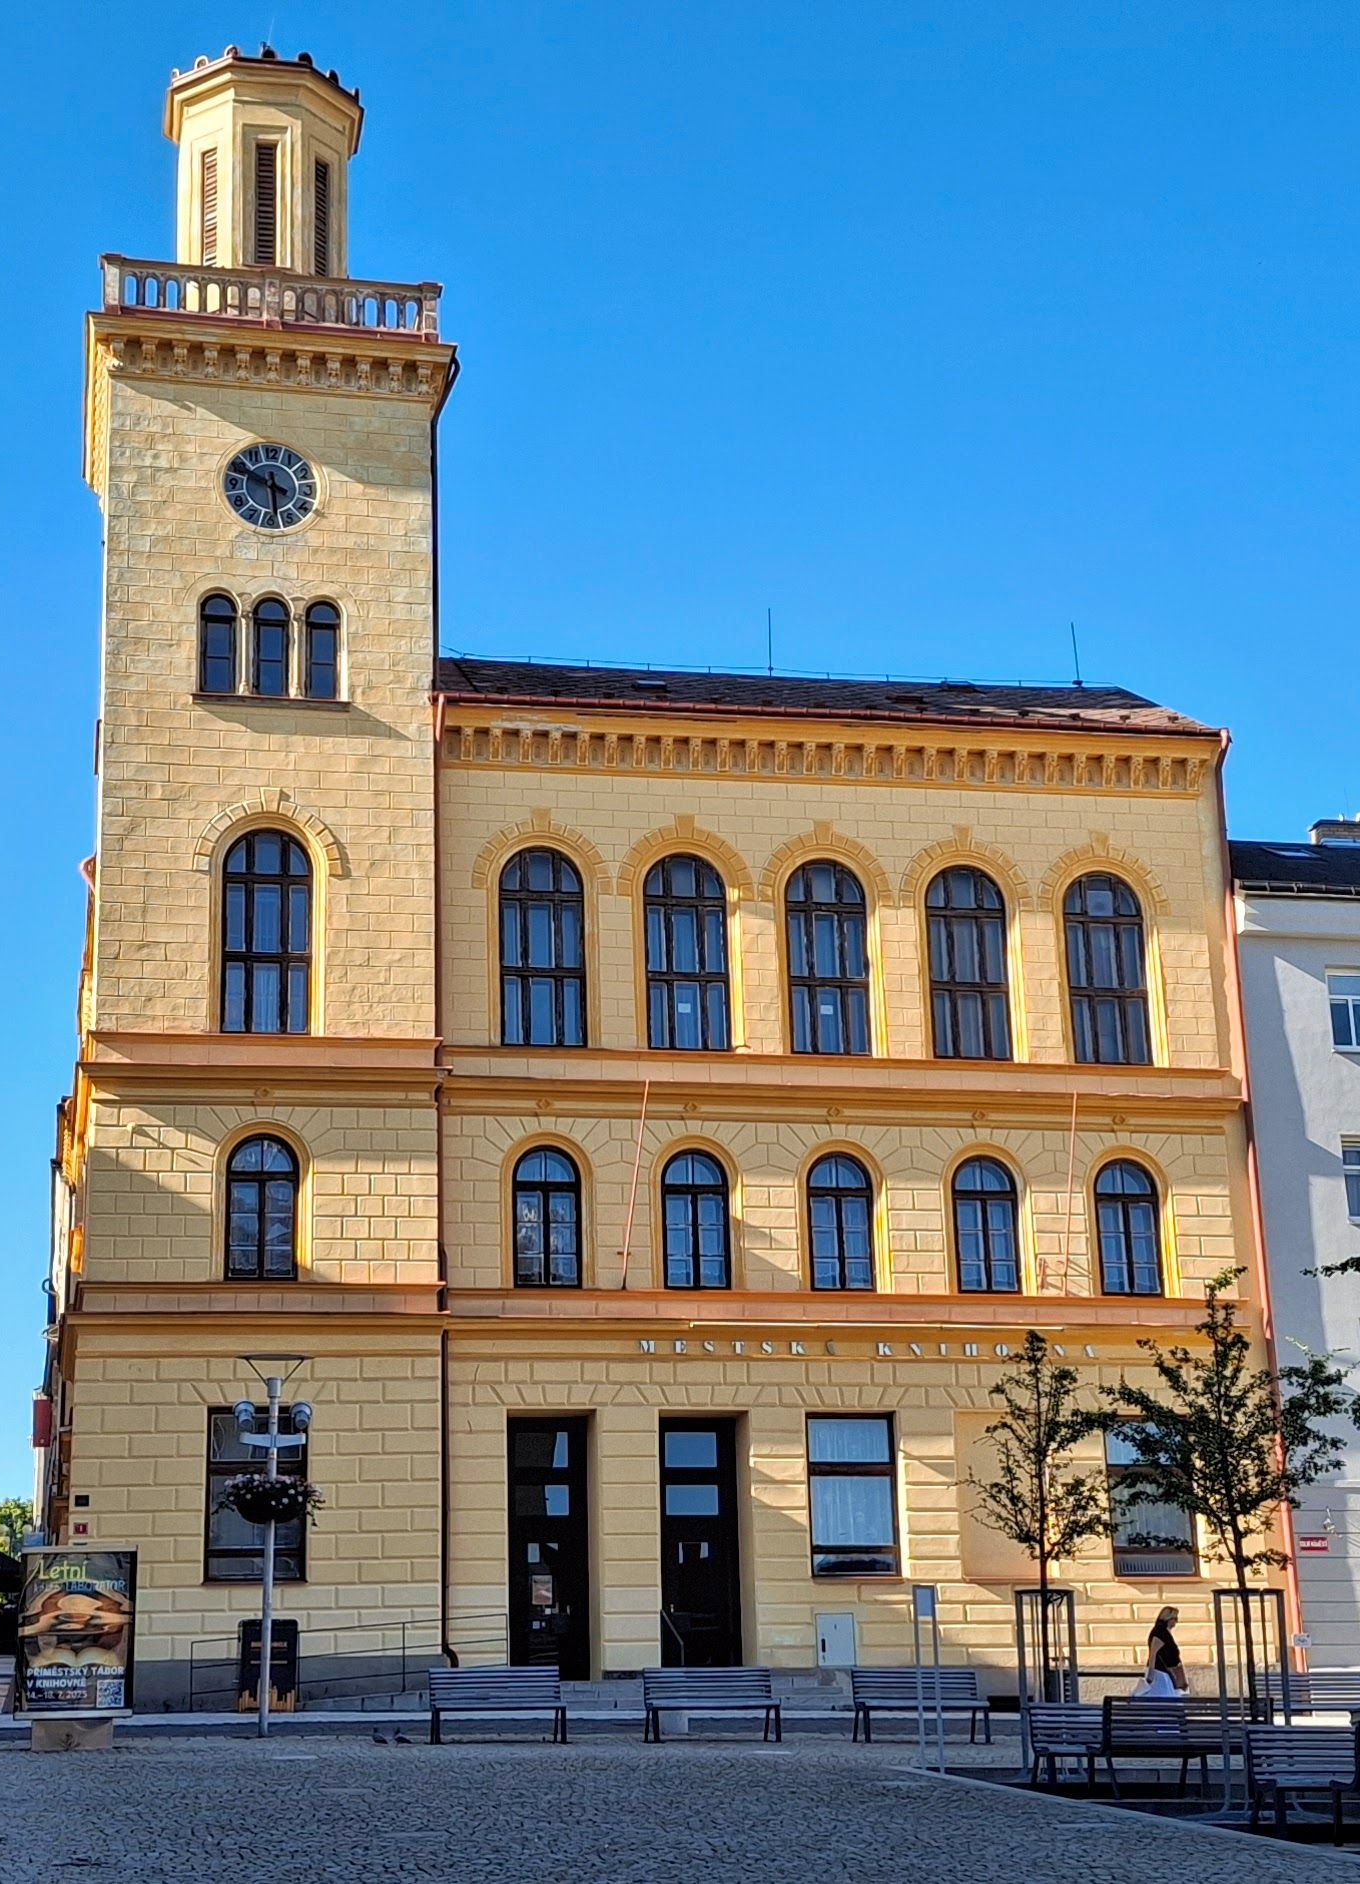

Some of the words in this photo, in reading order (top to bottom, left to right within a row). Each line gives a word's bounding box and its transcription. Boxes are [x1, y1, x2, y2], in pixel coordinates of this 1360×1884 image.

[248, 449, 258, 462] 11
[265, 447, 278, 460] 12
[300, 468, 308, 480] 2
[228, 477, 238, 490] 9
[303, 484, 313, 496] 3
[233, 495, 243, 507] 8
[298, 502, 309, 513] 4
[248, 508, 257, 520] 7
[286, 512, 294, 524] 5
[39, 1557, 88, 1580] Letní
